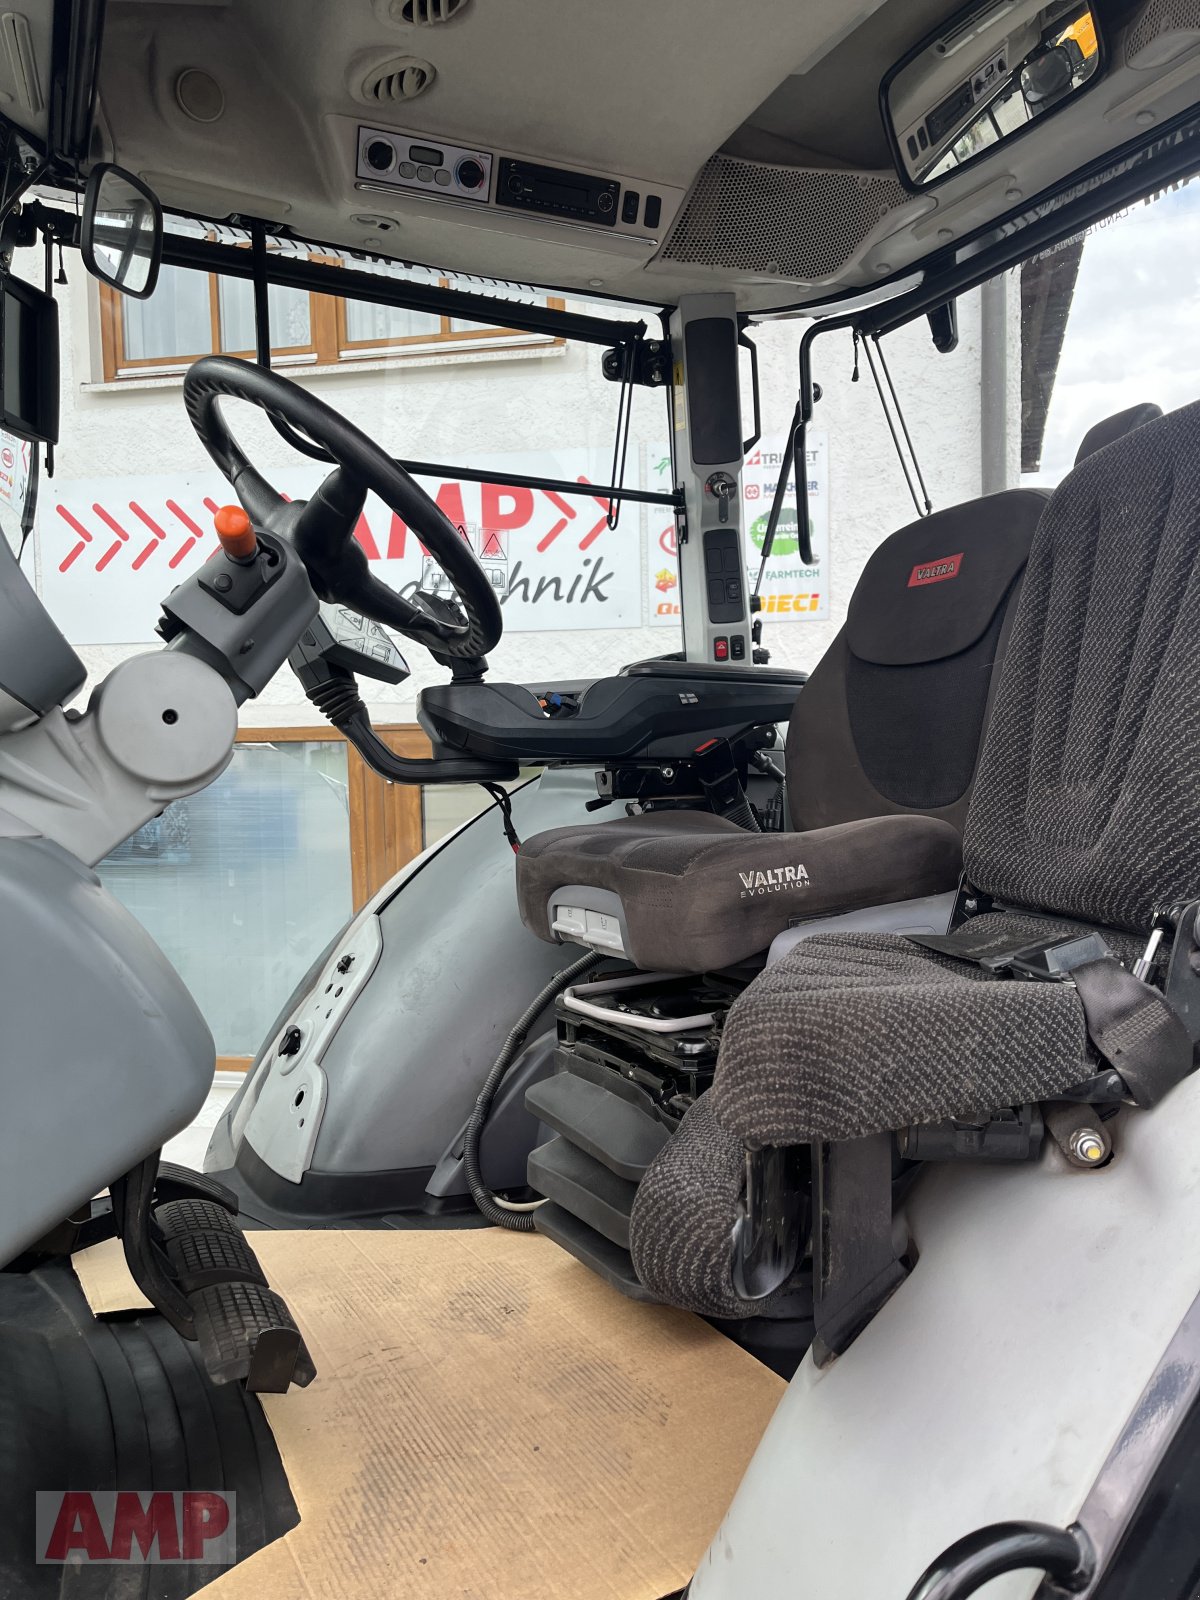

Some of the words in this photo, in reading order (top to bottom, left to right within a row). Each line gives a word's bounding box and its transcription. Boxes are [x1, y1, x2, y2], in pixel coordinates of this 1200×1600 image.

[761, 450, 819, 464] TRIET
[763, 481, 818, 493] MACHER
[765, 569, 820, 580] FARMTECH
[917, 562, 954, 580] VALTRA
[739, 864, 809, 889] VALTRA
[740, 879, 810, 898] EVOLUTION
